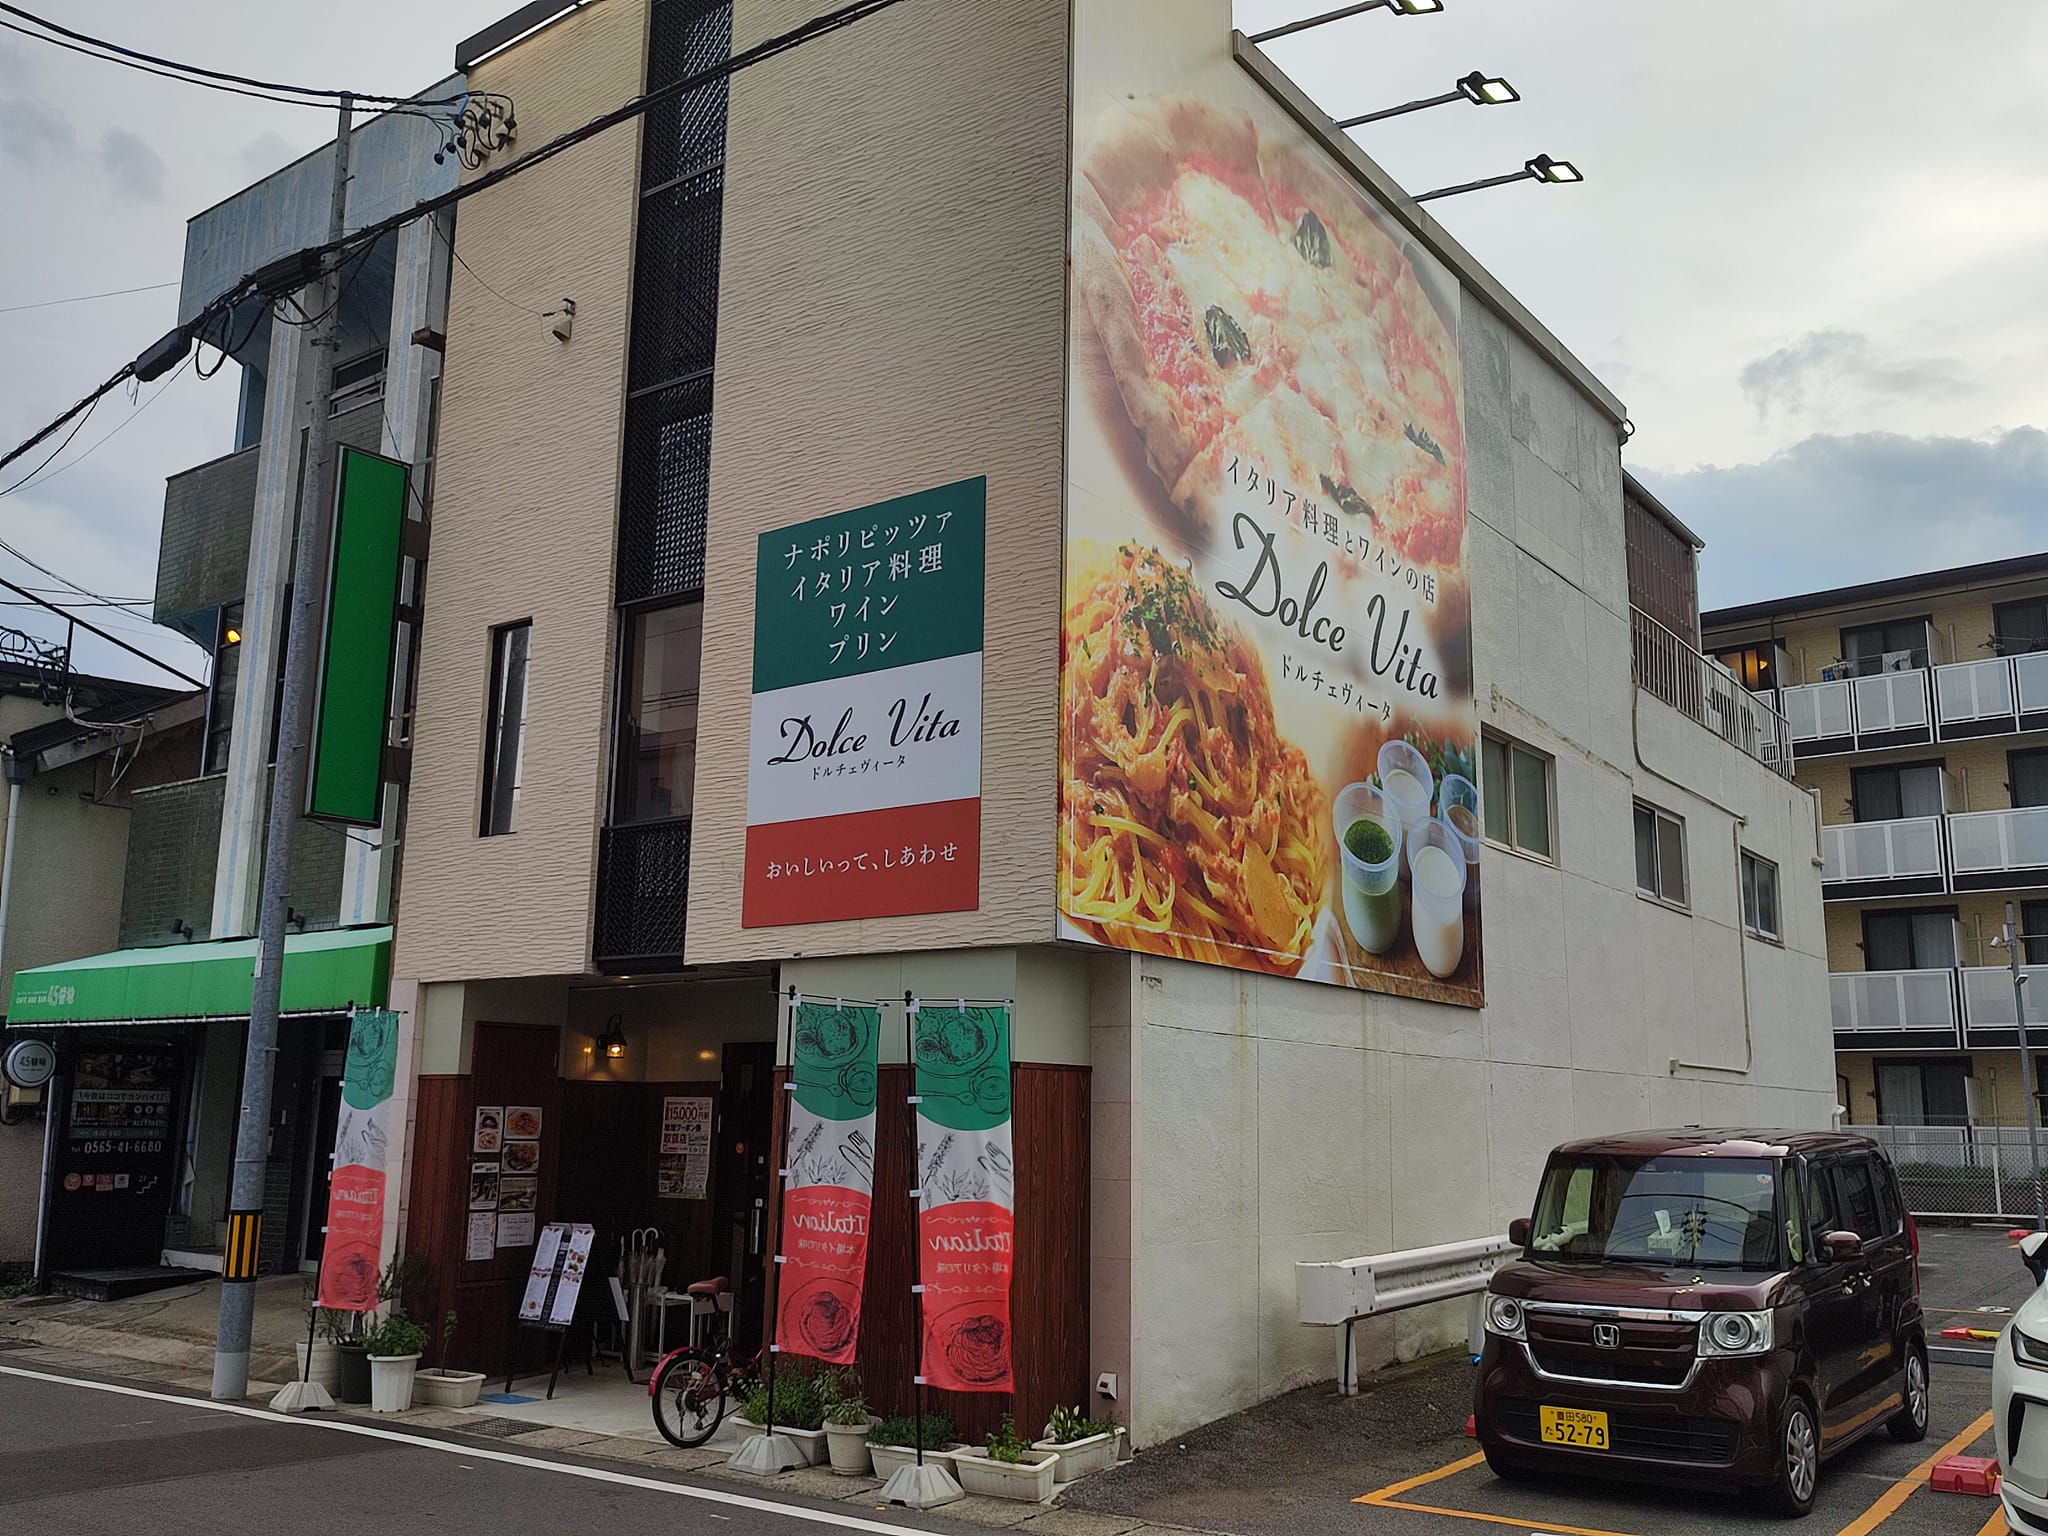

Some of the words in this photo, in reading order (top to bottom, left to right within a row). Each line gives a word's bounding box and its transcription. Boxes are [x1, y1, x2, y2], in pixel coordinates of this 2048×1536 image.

[784, 510, 954, 570] ナポリピッツァ
[1226, 455, 1437, 604] イタリア料理とワインの店
[790, 543, 945, 601] イタリア料理
[828, 593, 899, 628] ワイン
[1215, 512, 1346, 652] Dolce
[1366, 593, 1439, 700] Vita
[828, 630, 899, 665] プリン
[1281, 653, 1393, 721] ドルチェヴィータ
[767, 705, 867, 766] Dolce
[887, 691, 961, 745] Vita
[811, 753, 907, 781] ドルチェヴィータ
[765, 841, 959, 880] おいしいって、しあわせ
[83, 1139, 162, 1155] 0565-41-6680
[1555, 1422, 1606, 1446] 52-79
